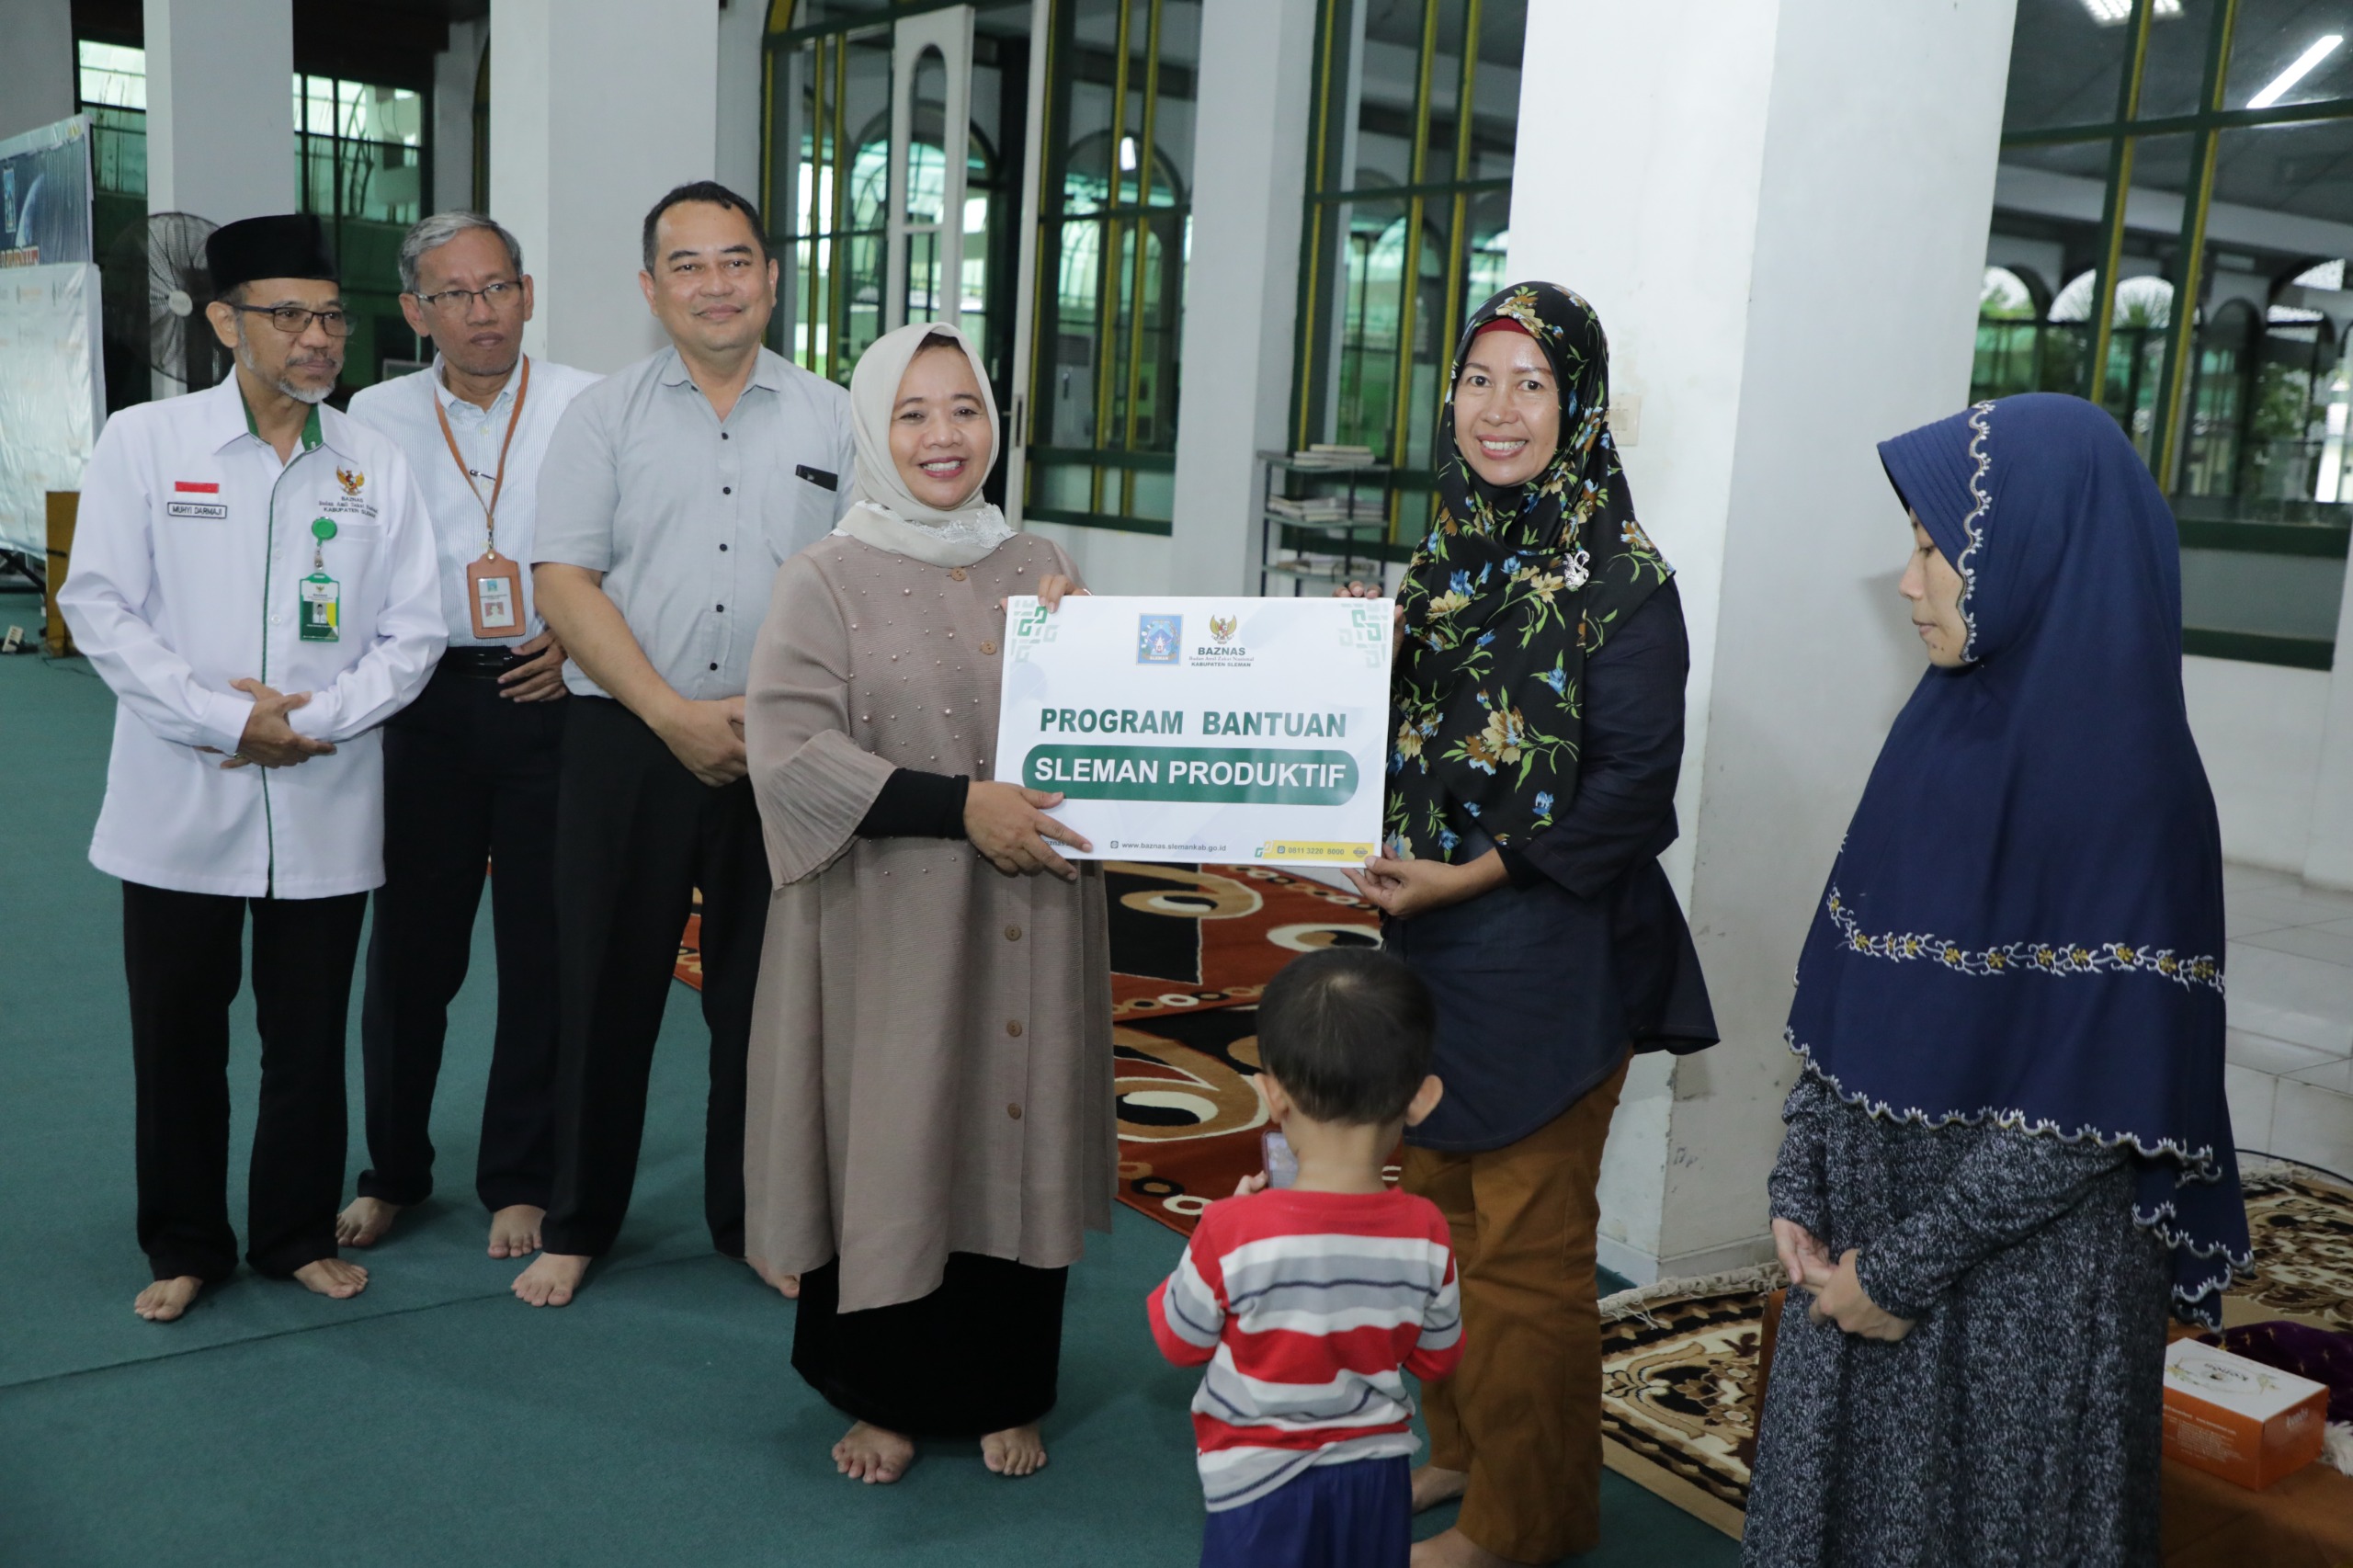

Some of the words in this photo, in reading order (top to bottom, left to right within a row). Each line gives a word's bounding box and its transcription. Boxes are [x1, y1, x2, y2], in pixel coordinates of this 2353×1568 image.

[172, 506, 193, 514] MUHYI
[194, 506, 222, 516] DARMAJI
[1198, 647, 1245, 655] BAZNAS
[1040, 708, 1184, 734] PROGRAM
[1202, 711, 1347, 737] BANTUAN
[1034, 757, 1159, 783] SLEMAN
[1168, 760, 1347, 788] PRODUKTIF
[1121, 842, 1227, 852] www.baznas.slemankab.go.id
